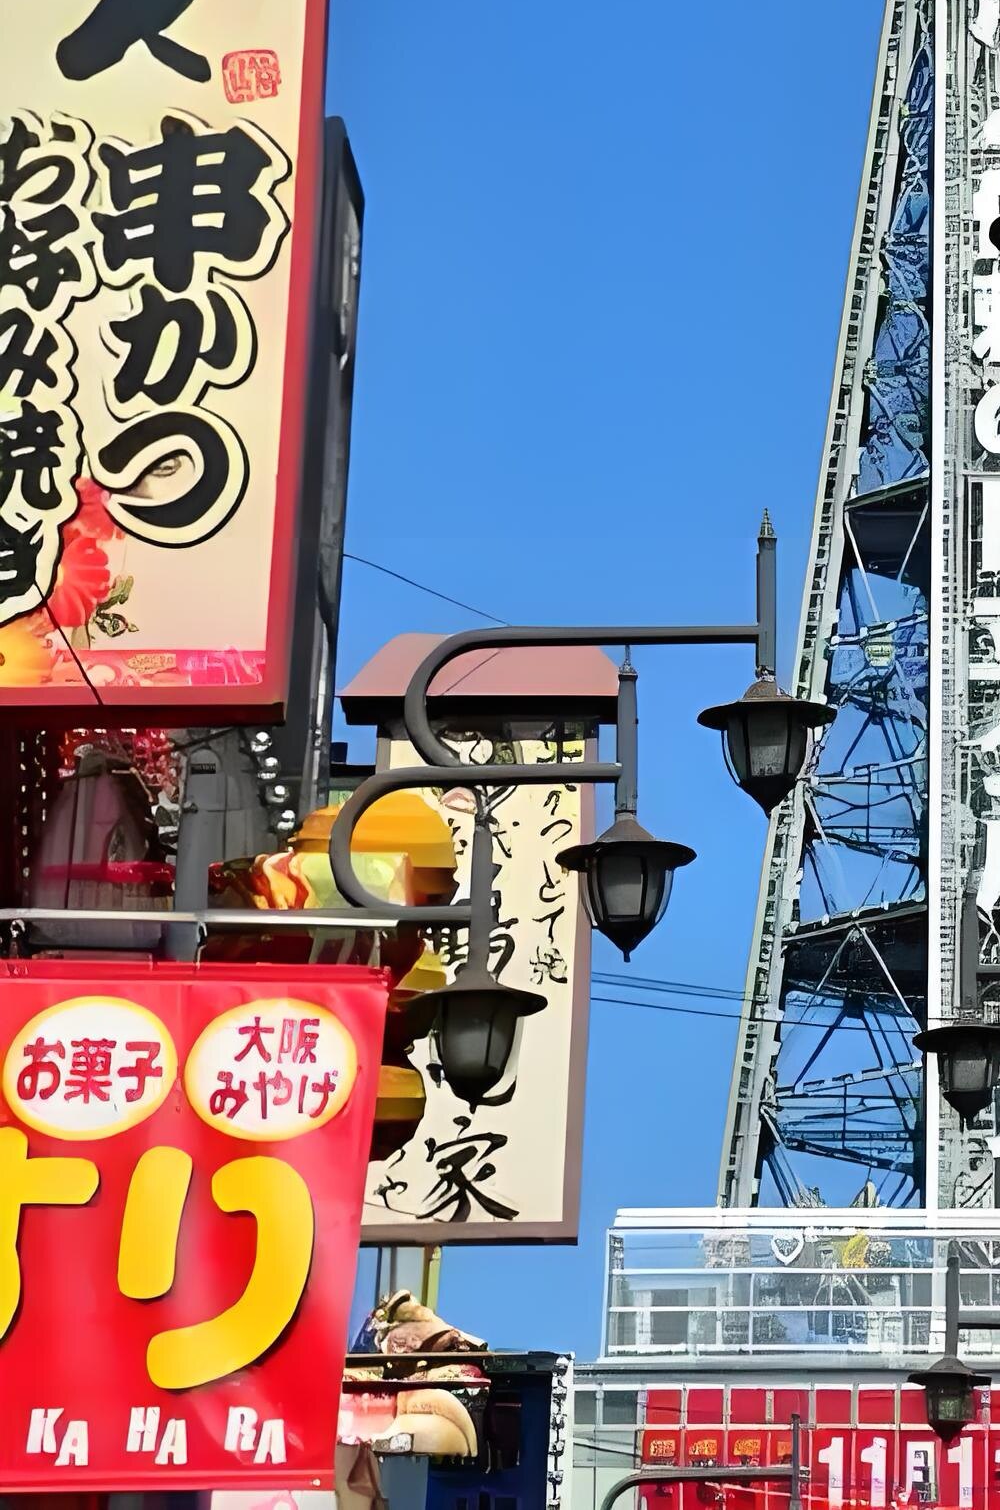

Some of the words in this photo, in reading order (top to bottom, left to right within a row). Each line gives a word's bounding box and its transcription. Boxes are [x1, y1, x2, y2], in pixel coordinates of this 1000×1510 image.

[93, 114, 275, 532] 串かつ
[16, 1036, 164, 1104] お菓子
[234, 1016, 321, 1065] 大阪
[209, 1069, 340, 1120] みやげ
[26, 1407, 89, 1467] KA
[126, 1406, 188, 1465] HA
[224, 1406, 287, 1465] RA
